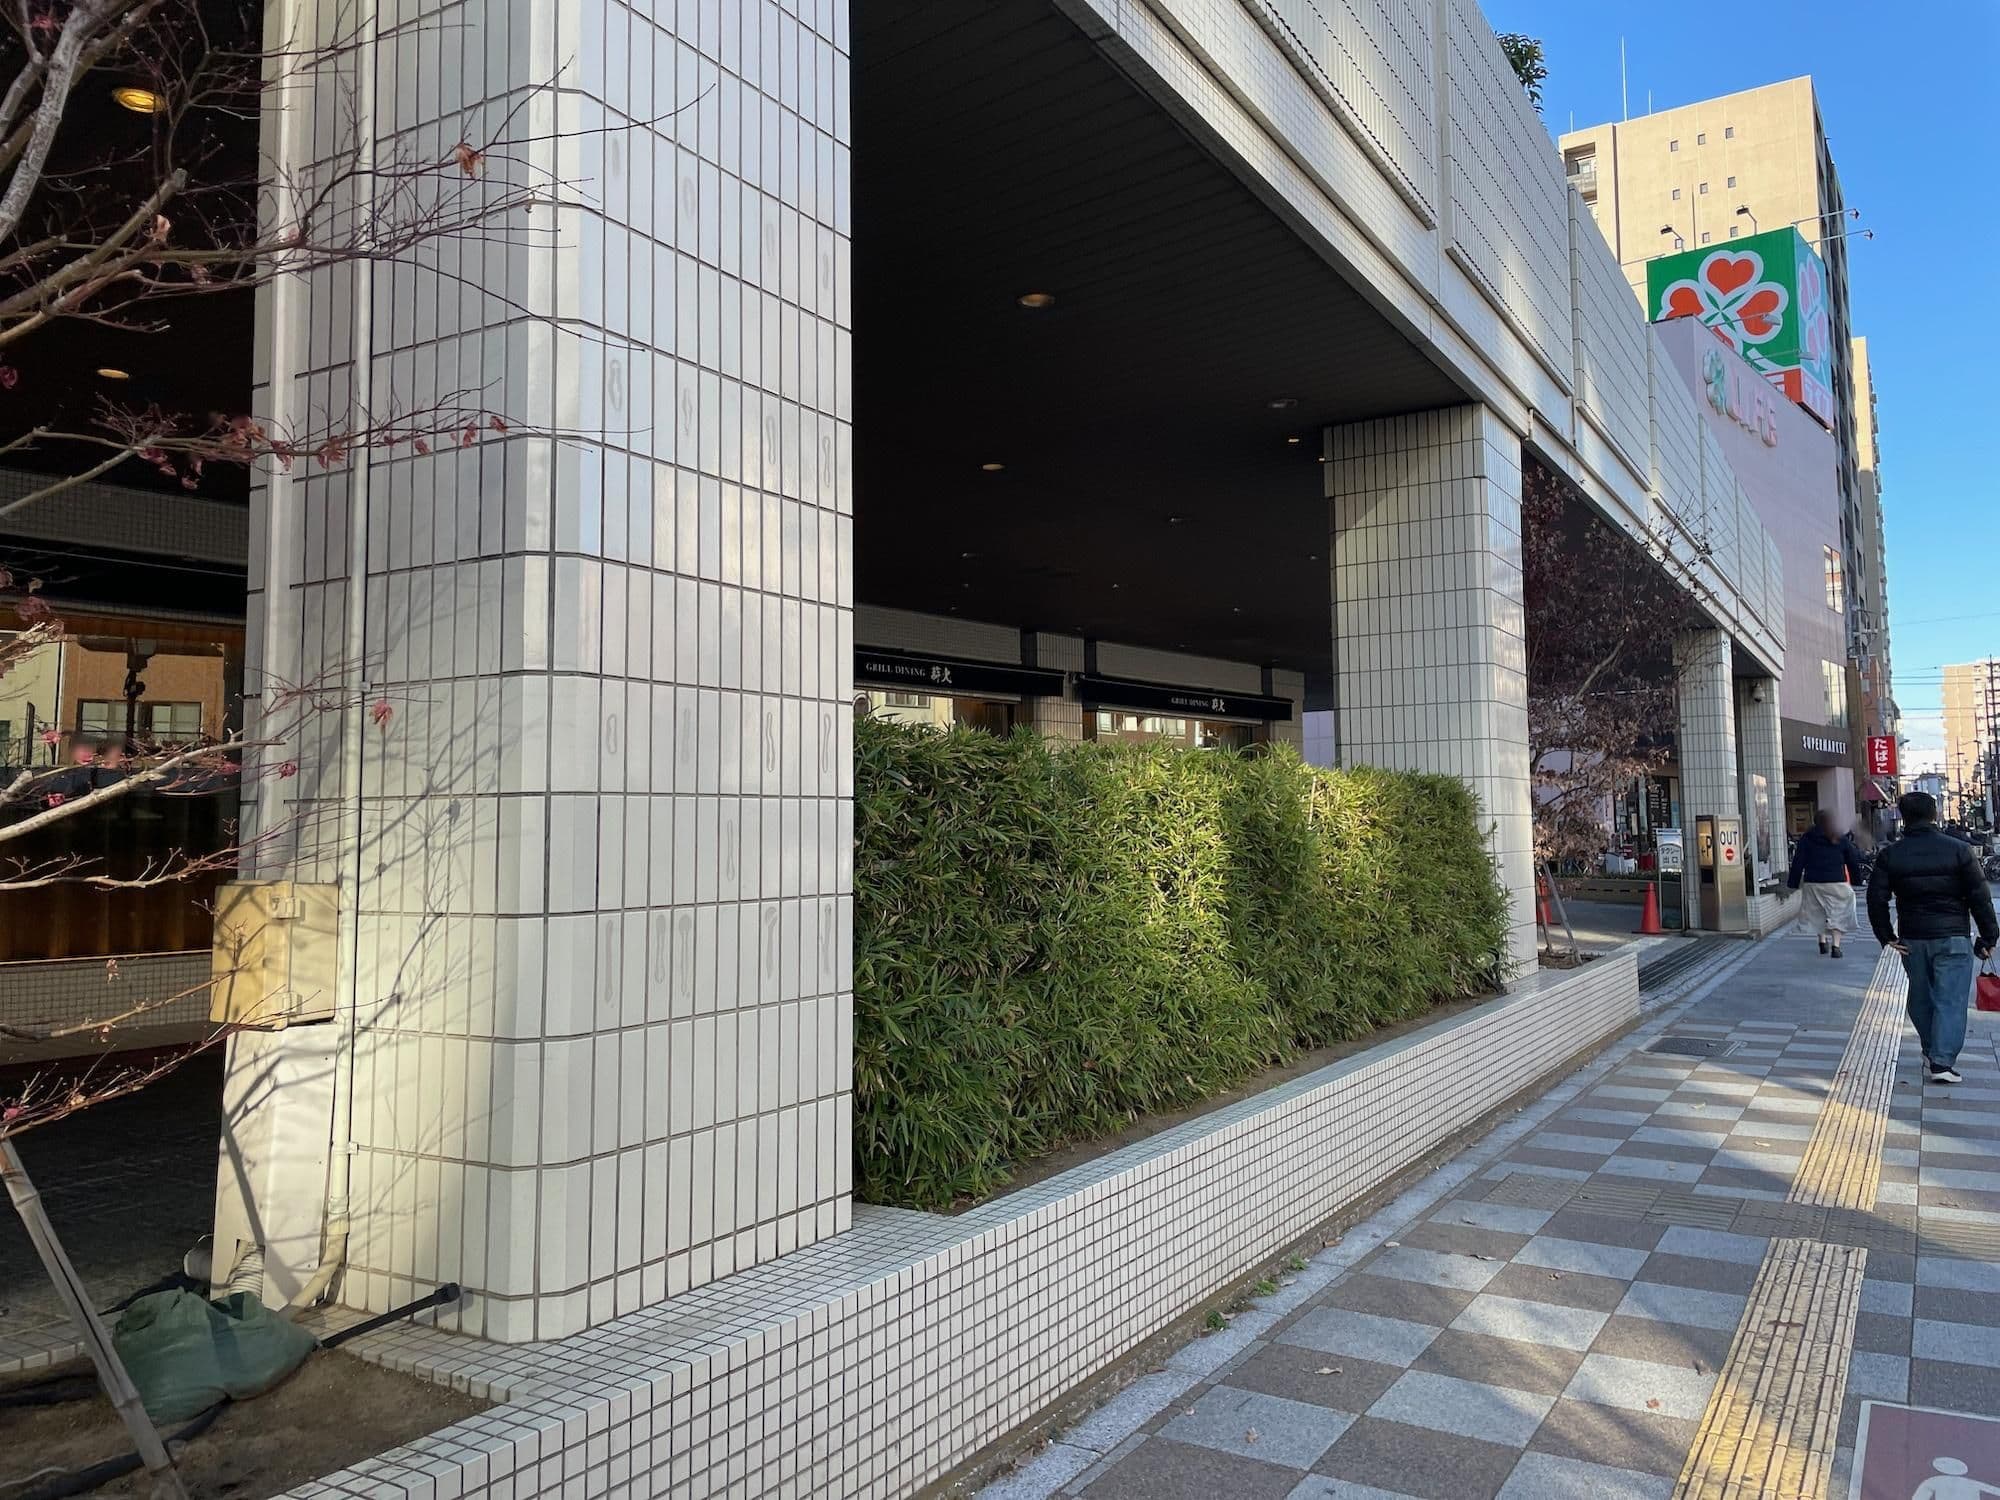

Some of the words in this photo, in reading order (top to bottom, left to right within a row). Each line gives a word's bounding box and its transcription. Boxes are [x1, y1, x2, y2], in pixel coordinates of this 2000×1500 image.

[1725, 364, 1777, 447] LIFE
[865, 663, 893, 673] GRILL
[895, 665, 926, 676] DINING
[1802, 735, 1847, 755] SUPERMARKET
[1874, 738, 1889, 774] たばこ
[1706, 836, 1713, 857] P
[1720, 831, 1738, 845] OUT
[1663, 856, 1678, 864] 出口
